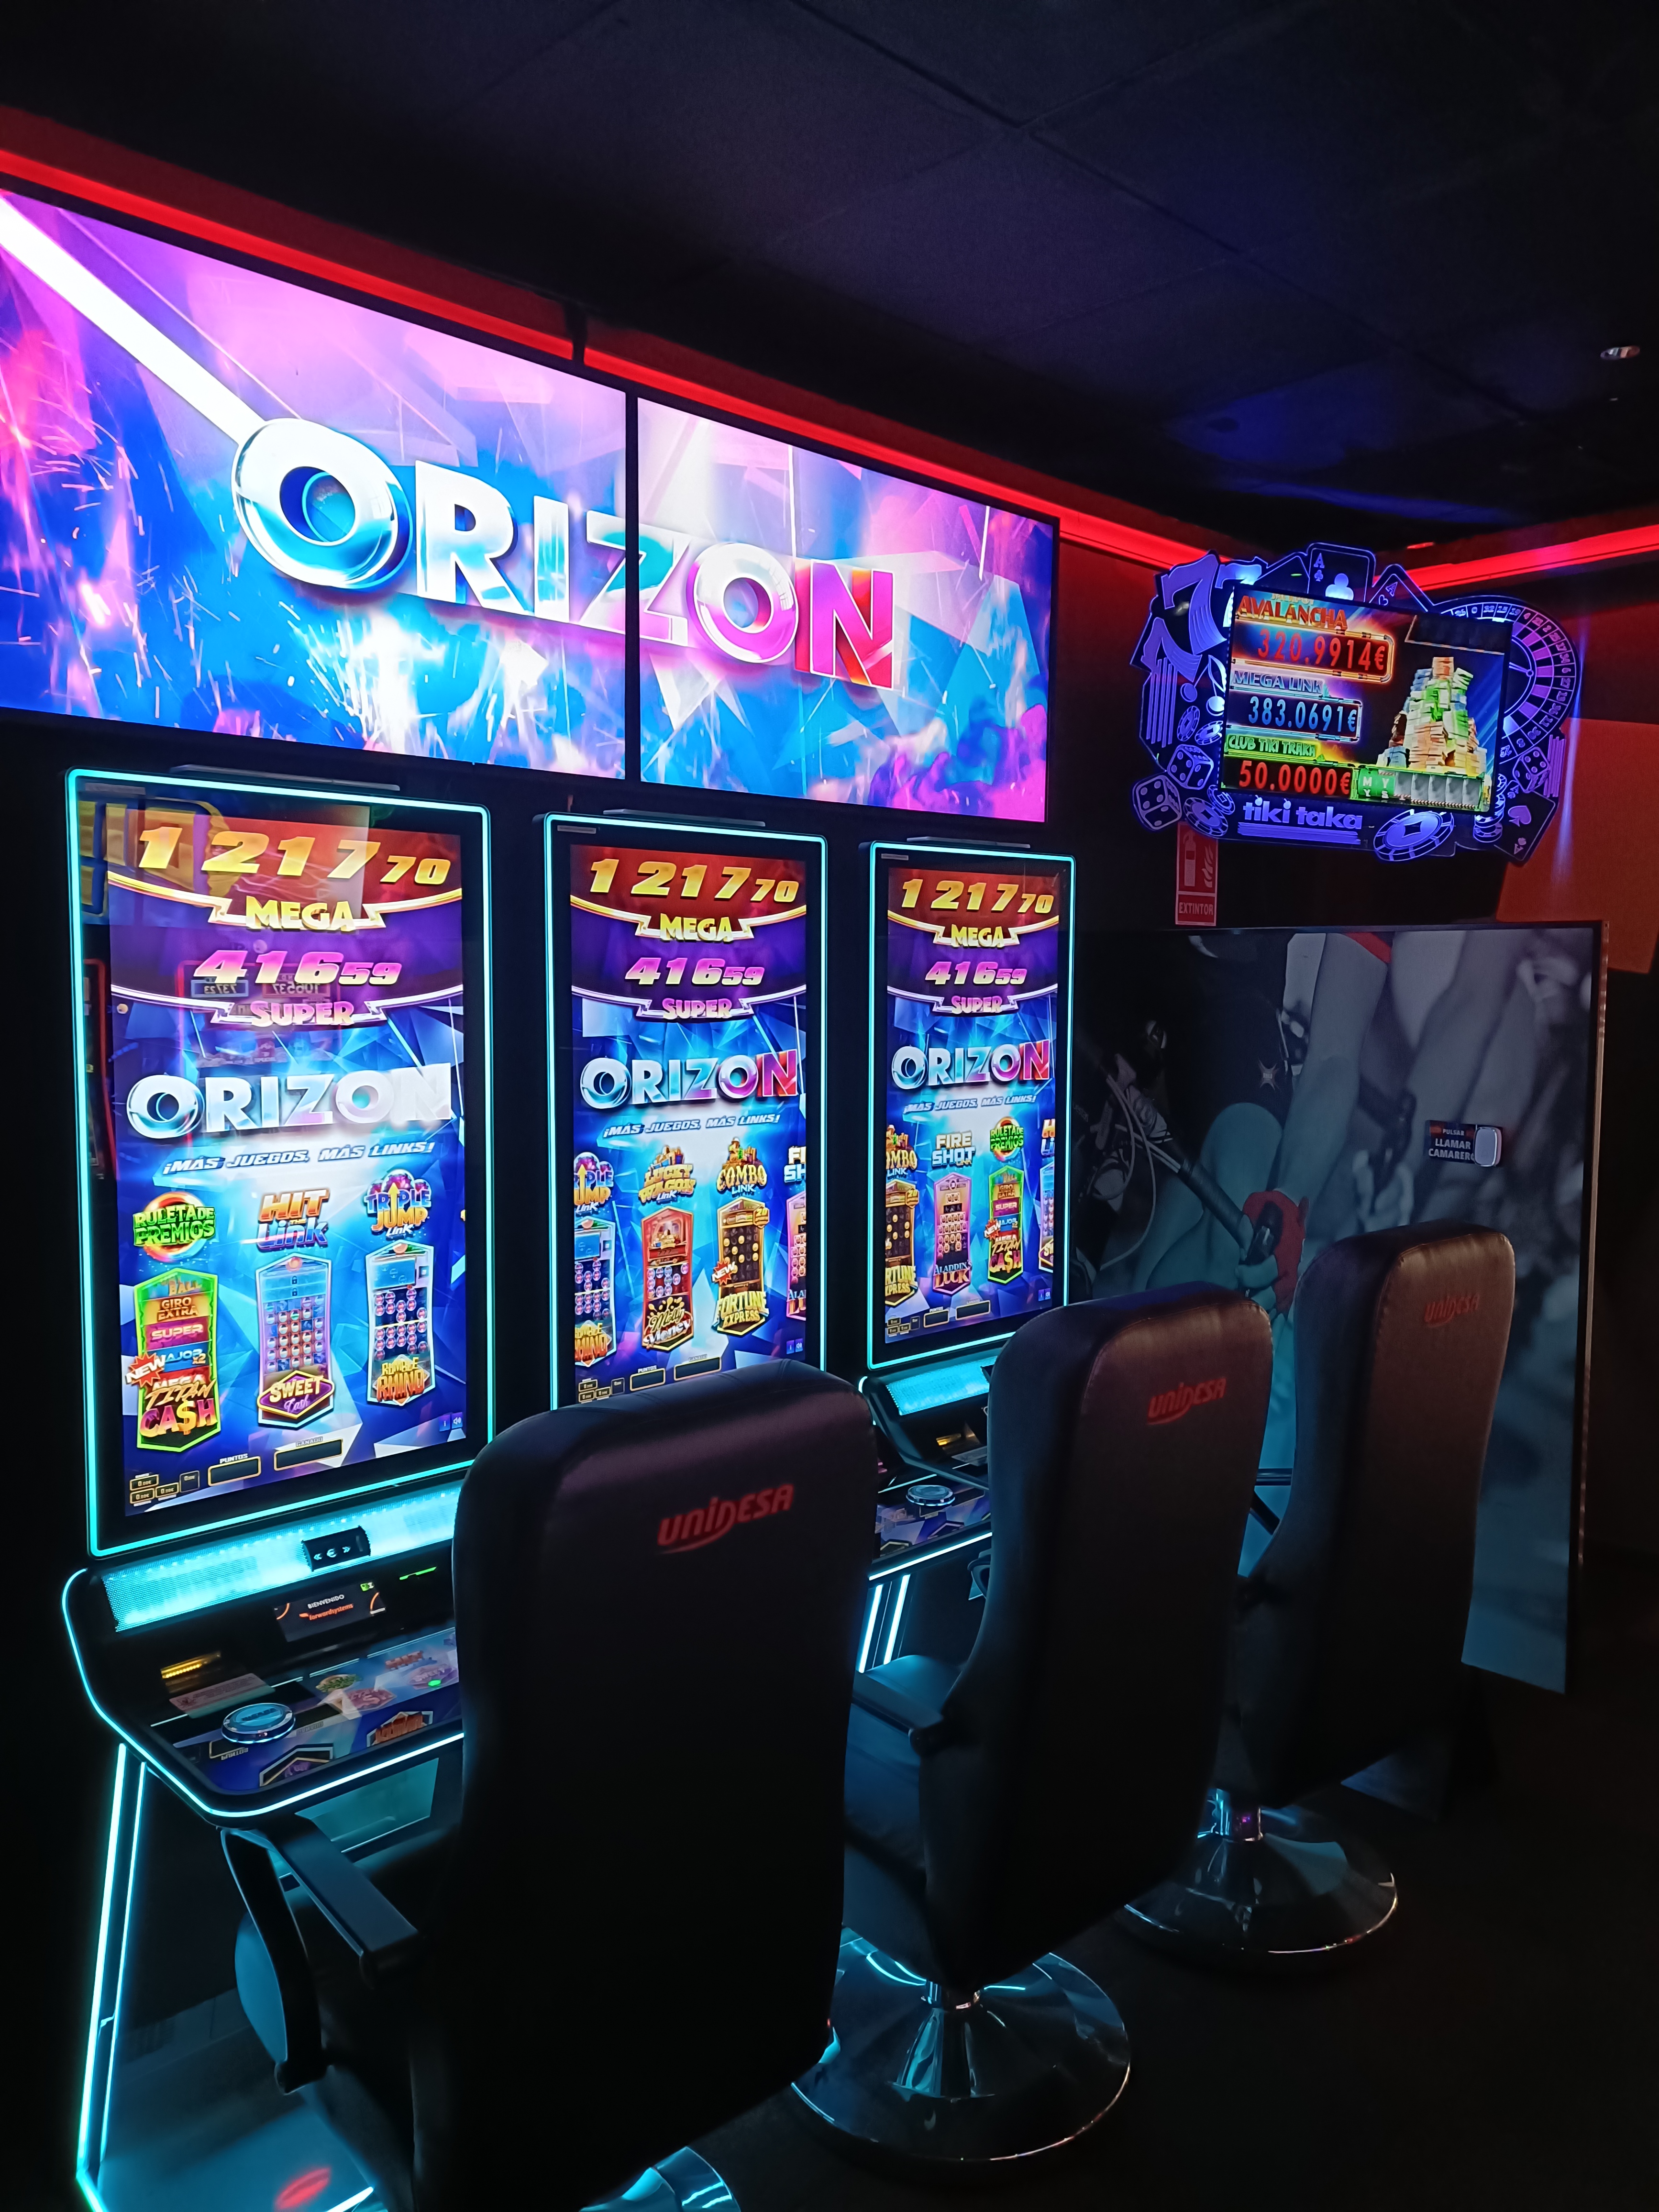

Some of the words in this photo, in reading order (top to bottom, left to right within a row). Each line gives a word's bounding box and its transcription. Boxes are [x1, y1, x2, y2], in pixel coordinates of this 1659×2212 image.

[232, 418, 894, 689] ORIZON
[1236, 595, 1348, 630] AVALANCHA
[1258, 628, 1385, 671] 320.9914€
[1233, 670, 1285, 690] MEGA
[1289, 676, 1323, 694] LINK
[1248, 696, 1357, 732] 383.0691€
[1228, 735, 1256, 751] CLUB
[1258, 738, 1279, 753] TIKI
[1239, 760, 1351, 795] 50.0000€
[1243, 795, 1291, 823] tiki
[1296, 807, 1362, 830] taka
[245, 896, 357, 932] MEGA
[1179, 902, 1214, 916] EXTINTOR
[660, 913, 734, 943] MEGA
[951, 924, 1005, 949] MEGA
[250, 1000, 354, 1027] SUPER
[662, 997, 733, 1020] SUPER
[951, 995, 1003, 1015] SUPER
[891, 1038, 1051, 1090] ORIZON
[580, 1049, 798, 1109] ORIZON
[126, 1062, 452, 1139] ORIZON
[645, 1118, 700, 1133] JUEGOS,
[706, 1115, 736, 1128] MÁS
[738, 1114, 781, 1126] LINKS!
[936, 1131, 973, 1150] FIRE
[990, 1135, 1024, 1151] PREMIOS
[1435, 1138, 1471, 1150] LLAMAR
[163, 1156, 222, 1174] ¡MÁS
[226, 1150, 310, 1168] JUEGOS,
[319, 1144, 365, 1161] MÁS
[368, 1141, 434, 1157] LINKS!
[932, 1146, 976, 1168] SHOT
[644, 1164, 694, 1188] LUCKY
[717, 1164, 767, 1192] COMBO
[574, 1186, 611, 1206] UMP
[638, 1178, 697, 1204] WAGON
[134, 1204, 197, 1228] RULETA
[259, 1188, 330, 1223] HIT
[995, 1202, 1018, 1211] SUPER
[372, 1206, 428, 1232] JUMP
[984, 1220, 1001, 1237] NEW
[134, 1220, 216, 1246] PREMIOS
[257, 1217, 329, 1250] Link
[711, 1261, 736, 1282] NEW
[933, 1269, 970, 1288] LUCK
[934, 1260, 973, 1275] ALADDIN'S
[157, 1306, 199, 1321] EXTRA
[162, 1297, 192, 1309] GIRO
[718, 1291, 769, 1317] FORTUNE
[649, 1308, 685, 1333] Molly
[722, 1310, 761, 1329] EXPRESS
[151, 1324, 204, 1340] SUPER
[643, 1319, 691, 1347] Money
[165, 1349, 203, 1362] AJOR
[382, 1357, 419, 1375] RUMBLE
[126, 1355, 166, 1383] NEW
[638, 1365, 657, 1373] PUNTOS
[144, 1379, 217, 1411] TITAN
[269, 1375, 324, 1403] SWEET
[376, 1369, 425, 1403] RHINO
[296, 1436, 323, 1447] GANADO
[219, 1453, 248, 1464] PUNTOS
[308, 1594, 345, 1609] BIENVENIDO
[309, 1603, 354, 1621] forwardsystems
